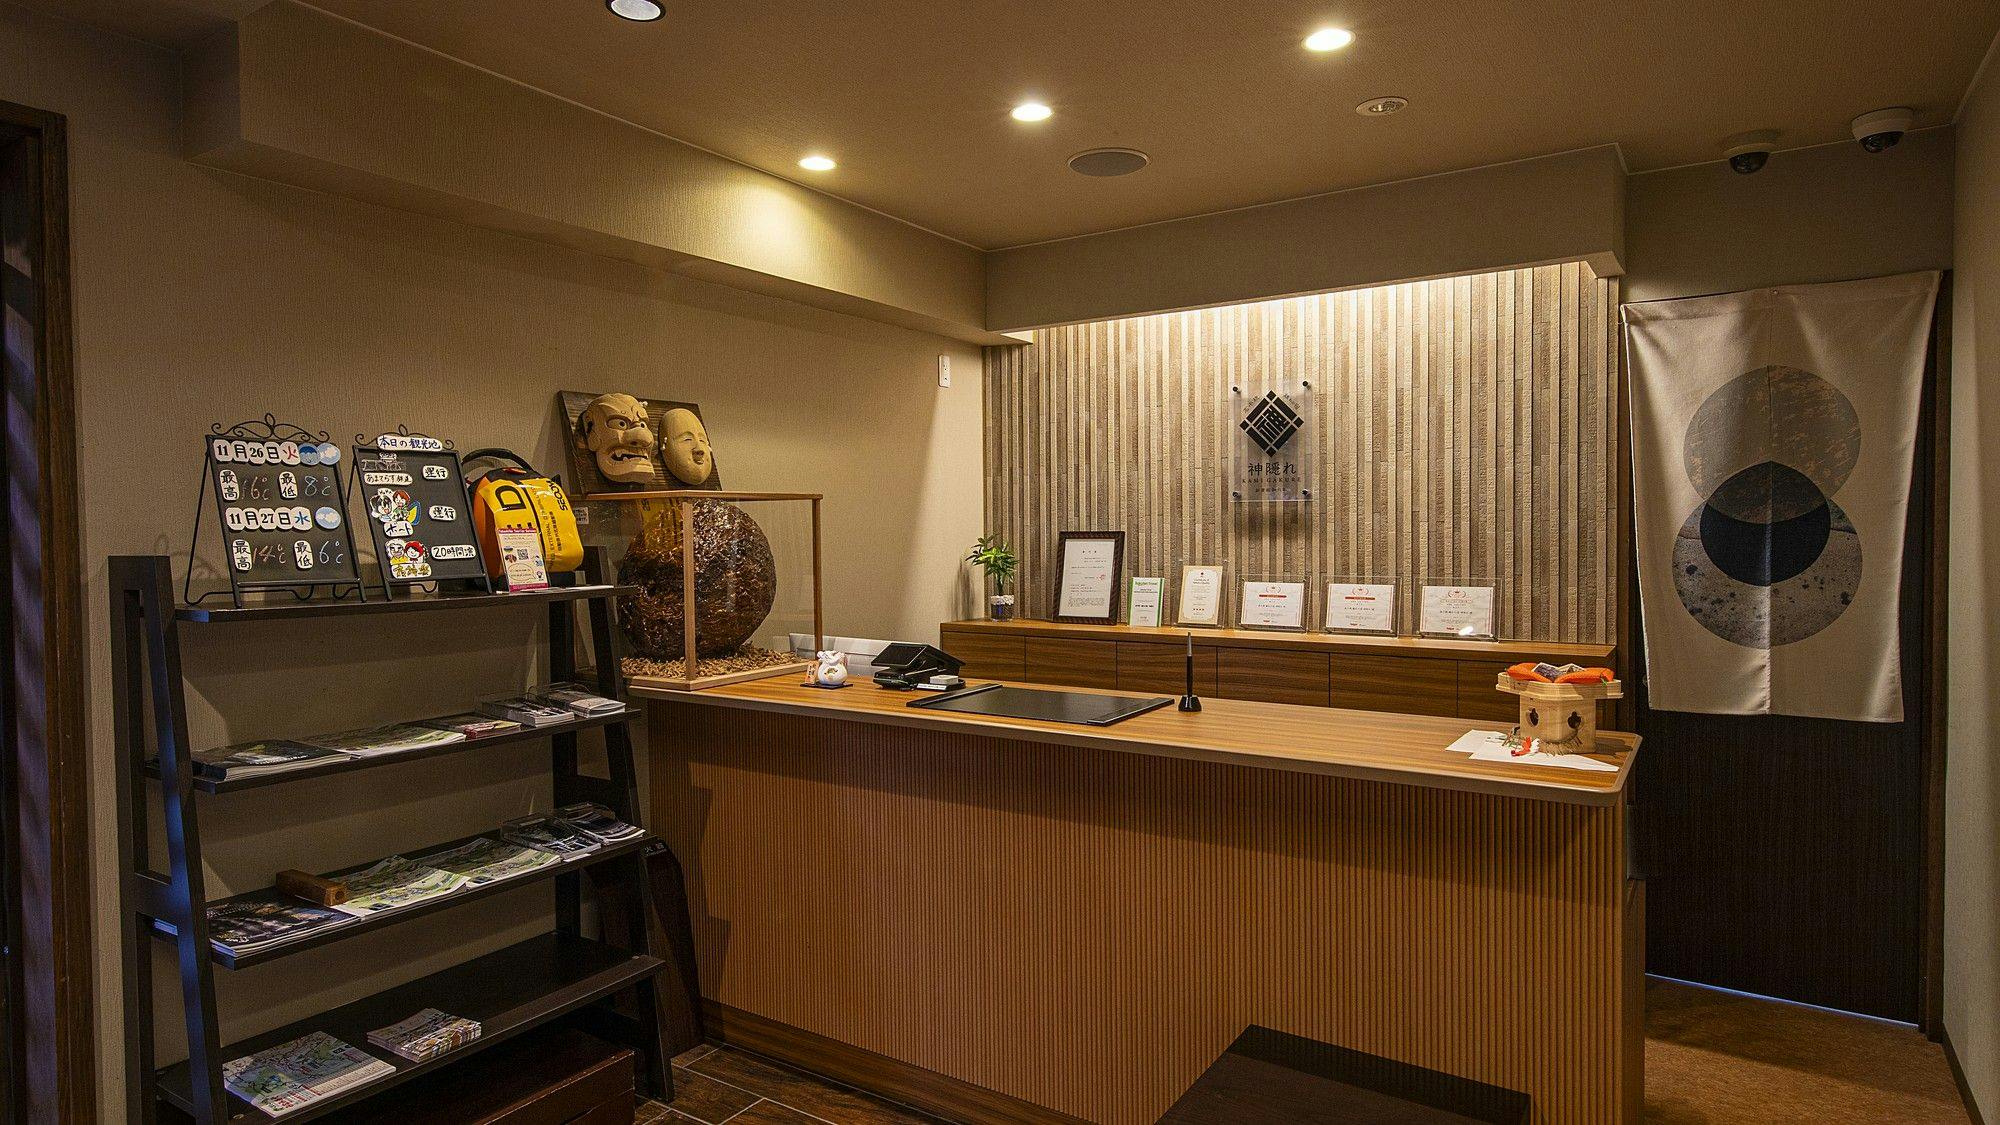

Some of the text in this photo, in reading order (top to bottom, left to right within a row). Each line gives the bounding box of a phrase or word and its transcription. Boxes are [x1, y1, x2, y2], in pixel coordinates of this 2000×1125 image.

[379, 435, 441, 450] 本日の観光地
[217, 443, 299, 460] 11月26日火
[424, 466, 446, 478] 運行
[1248, 461, 1297, 476] 神隠れ
[221, 470, 238, 498] 最高
[280, 472, 297, 497] 最低
[229, 511, 310, 525] 11月27日水
[433, 506, 454, 519] 運行
[386, 522, 411, 535] ボート
[235, 540, 251, 570] 最高
[295, 541, 312, 566] 最低
